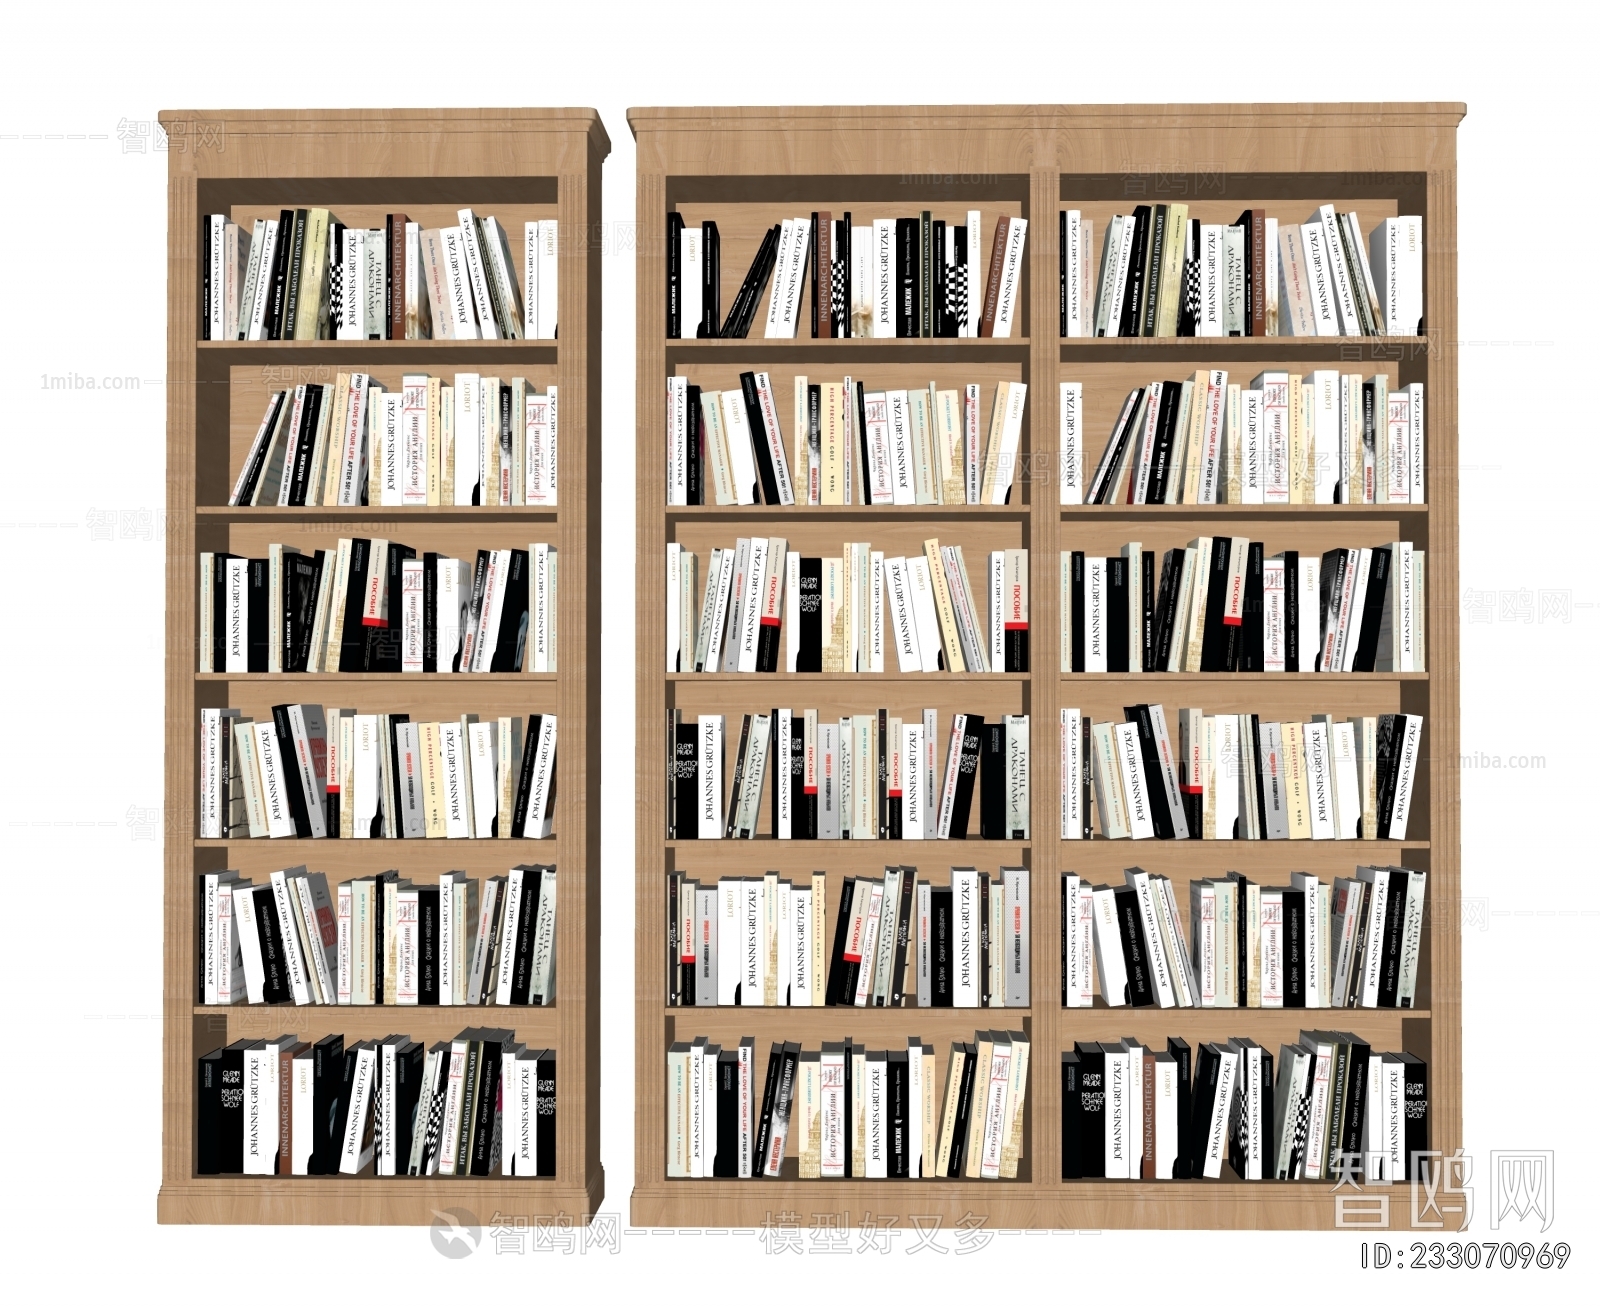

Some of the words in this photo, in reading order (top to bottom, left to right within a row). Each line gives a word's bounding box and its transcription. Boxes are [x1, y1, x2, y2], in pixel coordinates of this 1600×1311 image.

[447, 234, 460, 276] GRÜTZKE
[986, 223, 1006, 321] INNENARCHITEKTUR
[454, 277, 467, 323] JOHANNES
[894, 397, 903, 440] GRÜTZKE
[897, 441, 907, 488] JOHANNES
[369, 578, 378, 616] ПОСОБИЕ
[768, 577, 777, 615] ПОСОБИЕ
[892, 564, 905, 607] GRÜTZKE
[916, 564, 924, 591] LORIOT
[899, 607, 912, 654] JOHANNES
[447, 730, 456, 772] GRÜTZKE
[1124, 730, 1137, 773] GRÜTZKE
[450, 774, 459, 820] JOHANNES
[1131, 774, 1144, 821] JOHANNES
[851, 917, 861, 953] ПОСОБИЕ
